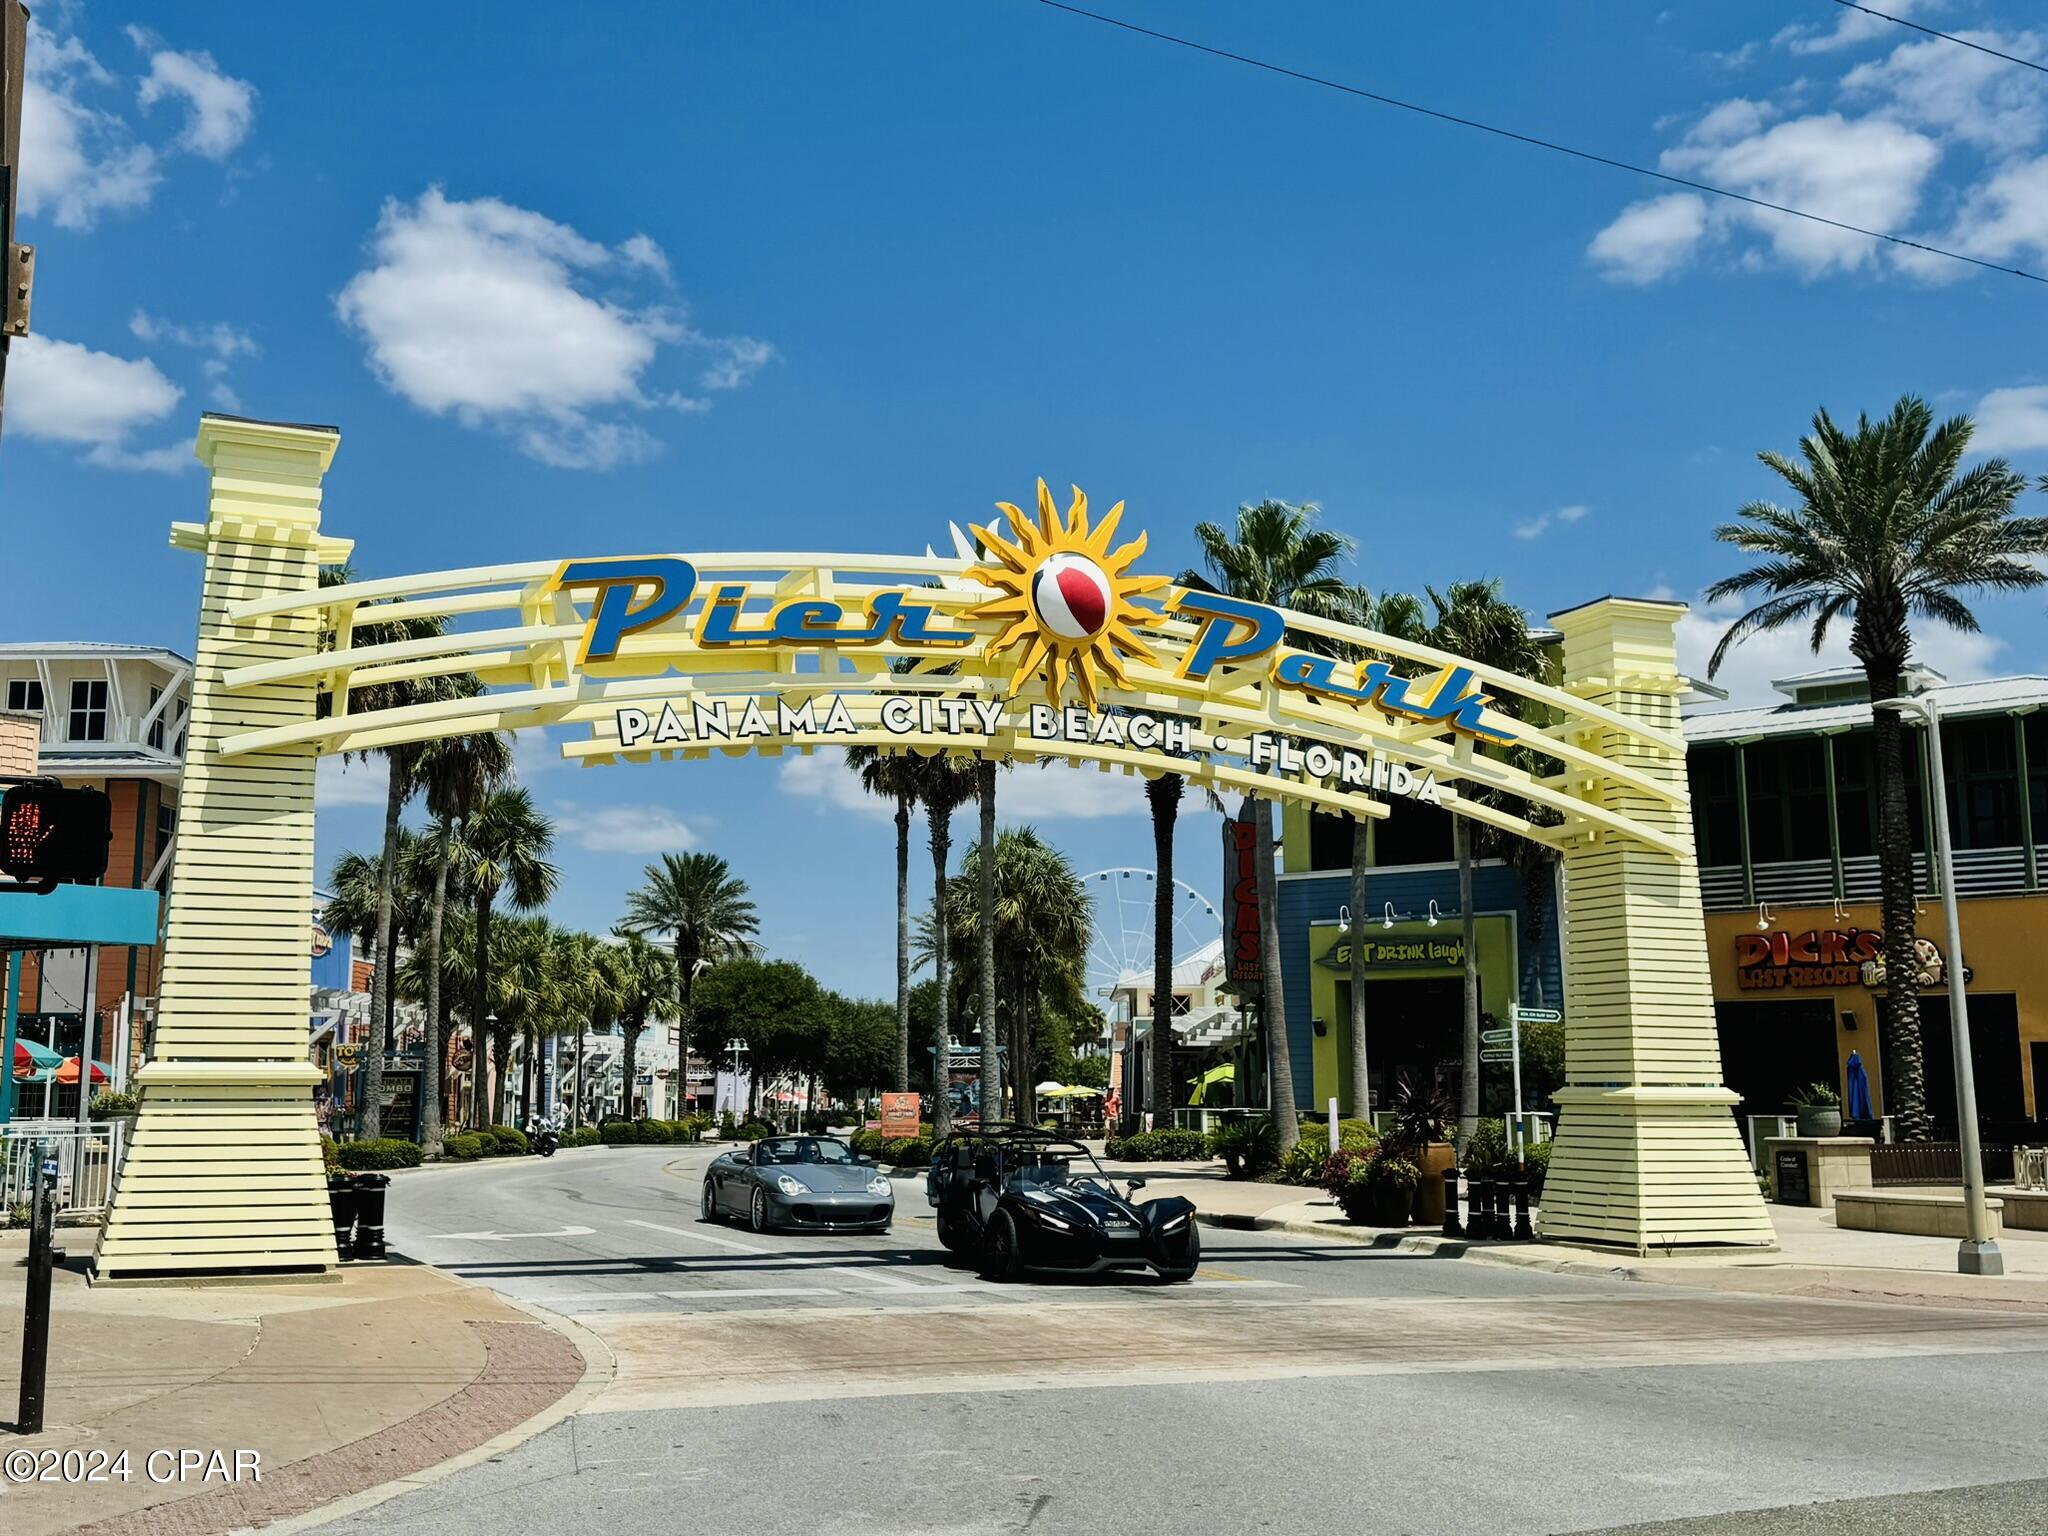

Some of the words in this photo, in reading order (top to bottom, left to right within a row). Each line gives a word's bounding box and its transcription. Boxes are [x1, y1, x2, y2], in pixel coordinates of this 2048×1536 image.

[553, 555, 977, 663] Pier
[1166, 587, 1521, 748] Park
[615, 695, 859, 747] PANAMA
[880, 696, 1004, 737] CITY
[1029, 703, 1193, 754] BEACH
[1250, 732, 1443, 806] FLORIDA
[1337, 943, 1375, 963] ET
[1377, 943, 1425, 960] DRINK
[1734, 929, 1882, 968] DICK'S
[1238, 962, 1260, 971] LAST
[1739, 967, 1787, 988] LAST
[1789, 965, 1860, 987] RESORT
